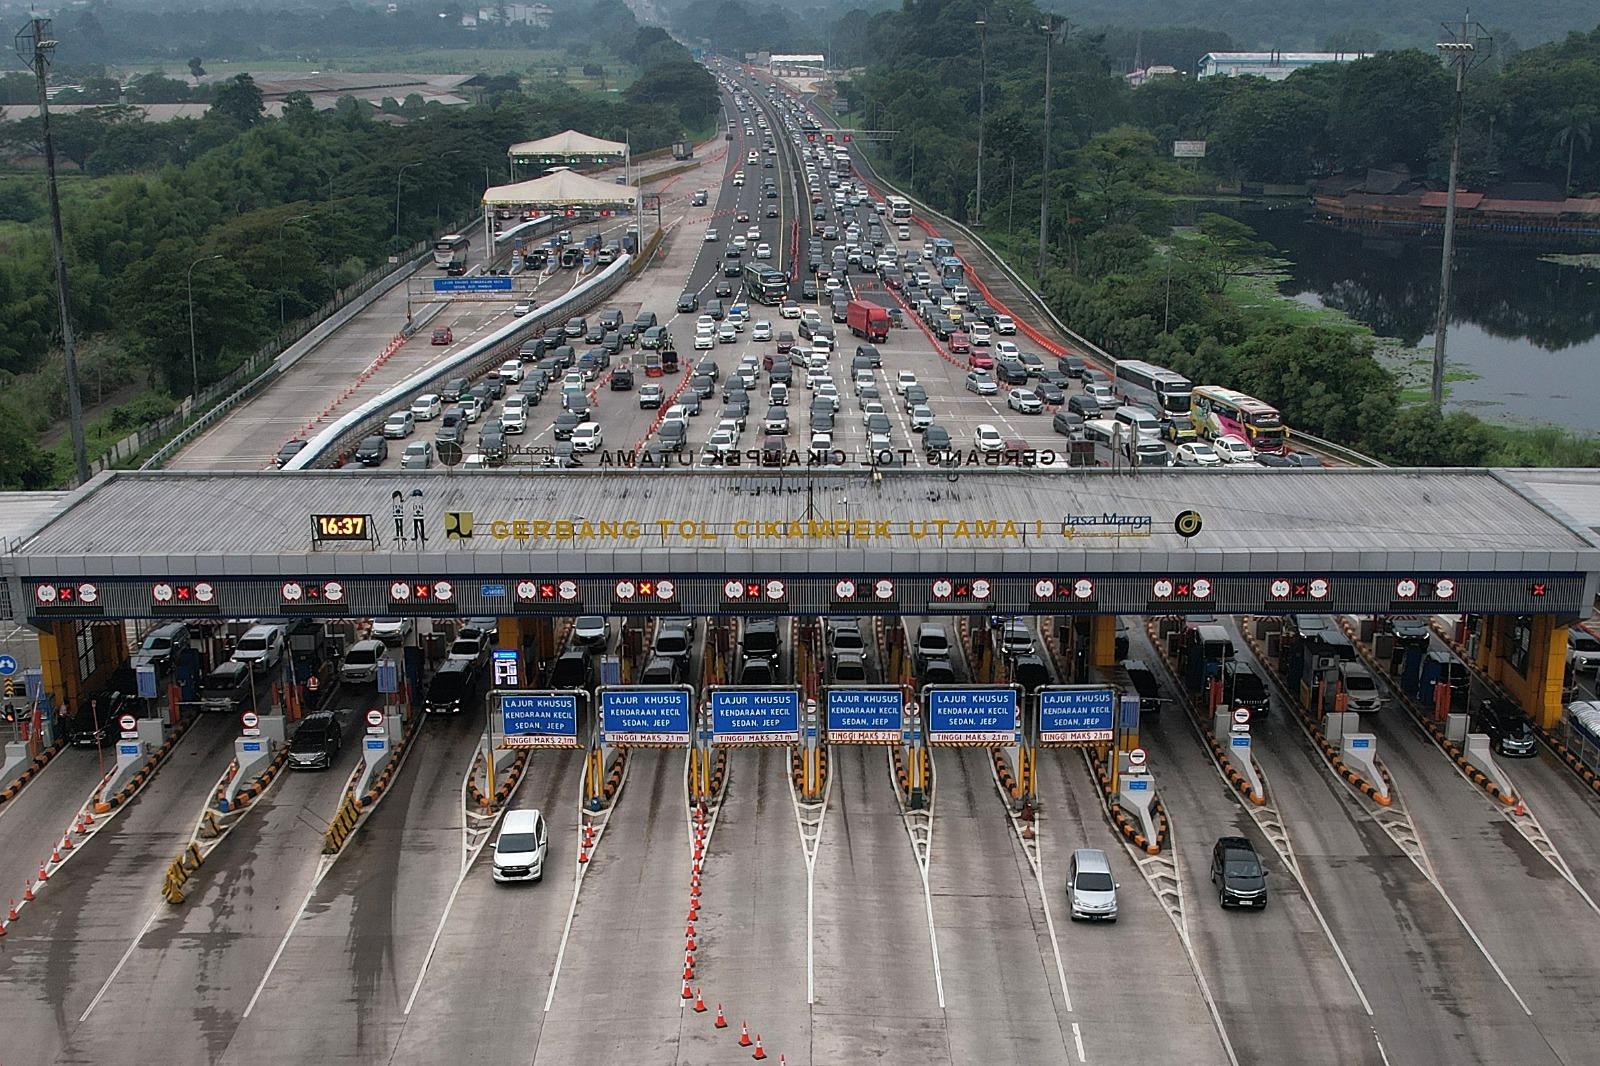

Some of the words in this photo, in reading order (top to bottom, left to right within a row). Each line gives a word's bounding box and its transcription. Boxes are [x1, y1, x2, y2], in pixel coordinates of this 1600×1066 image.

[320, 518, 364, 535] 16:37
[1066, 514, 1096, 526] Jasa
[1102, 512, 1152, 528] Marga
[491, 520, 641, 540] GERBANG
[656, 520, 717, 540] TOL
[734, 520, 892, 539] CIKAMPEK
[909, 520, 1018, 539] UTAMA
